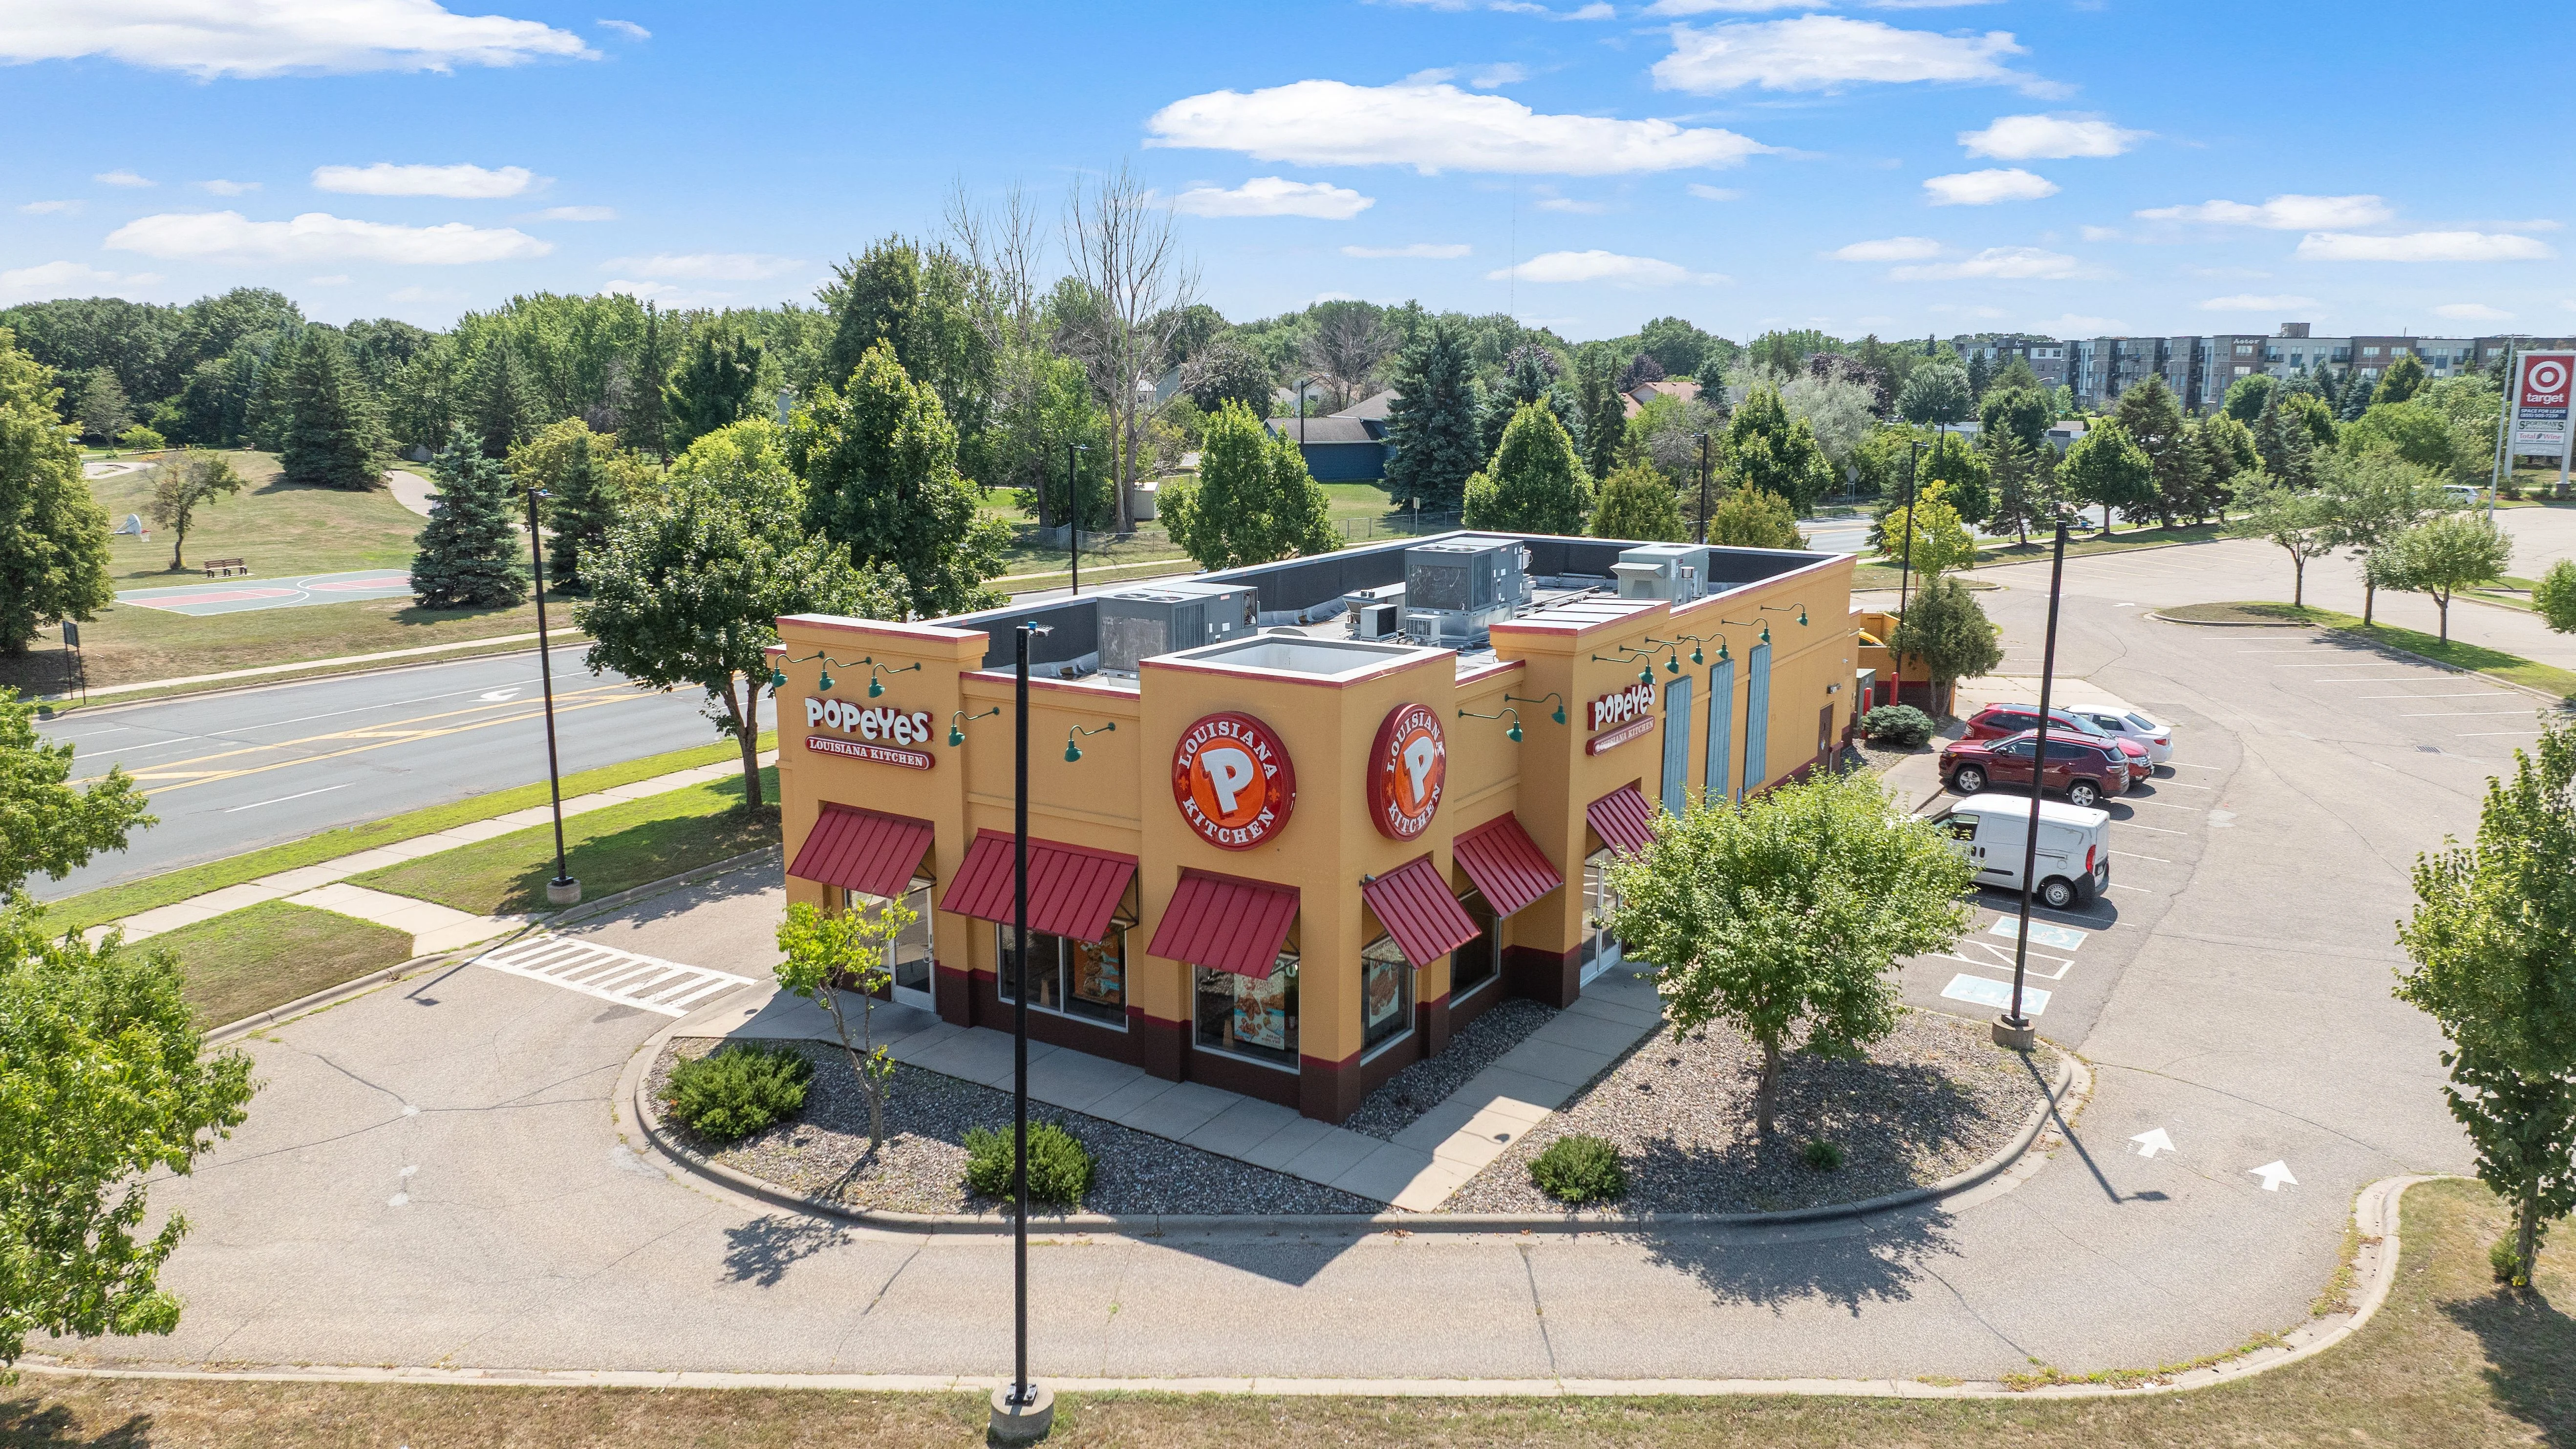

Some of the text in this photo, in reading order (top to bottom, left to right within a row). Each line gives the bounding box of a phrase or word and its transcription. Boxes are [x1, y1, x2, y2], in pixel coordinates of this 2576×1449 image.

[2526, 393, 2564, 404] target
[810, 739, 923, 767] LOUISIANA KITCHEN
[1179, 721, 1277, 779] LOUISIANA
[1387, 712, 1445, 773] LOUISIANA
[1595, 720, 1654, 752] LOUISIANA KITCHEN
[1201, 747, 1254, 813] P
[1403, 736, 1434, 804] P
[1182, 796, 1275, 844] KITCHEN
[1388, 783, 1440, 833] KITCHEN
